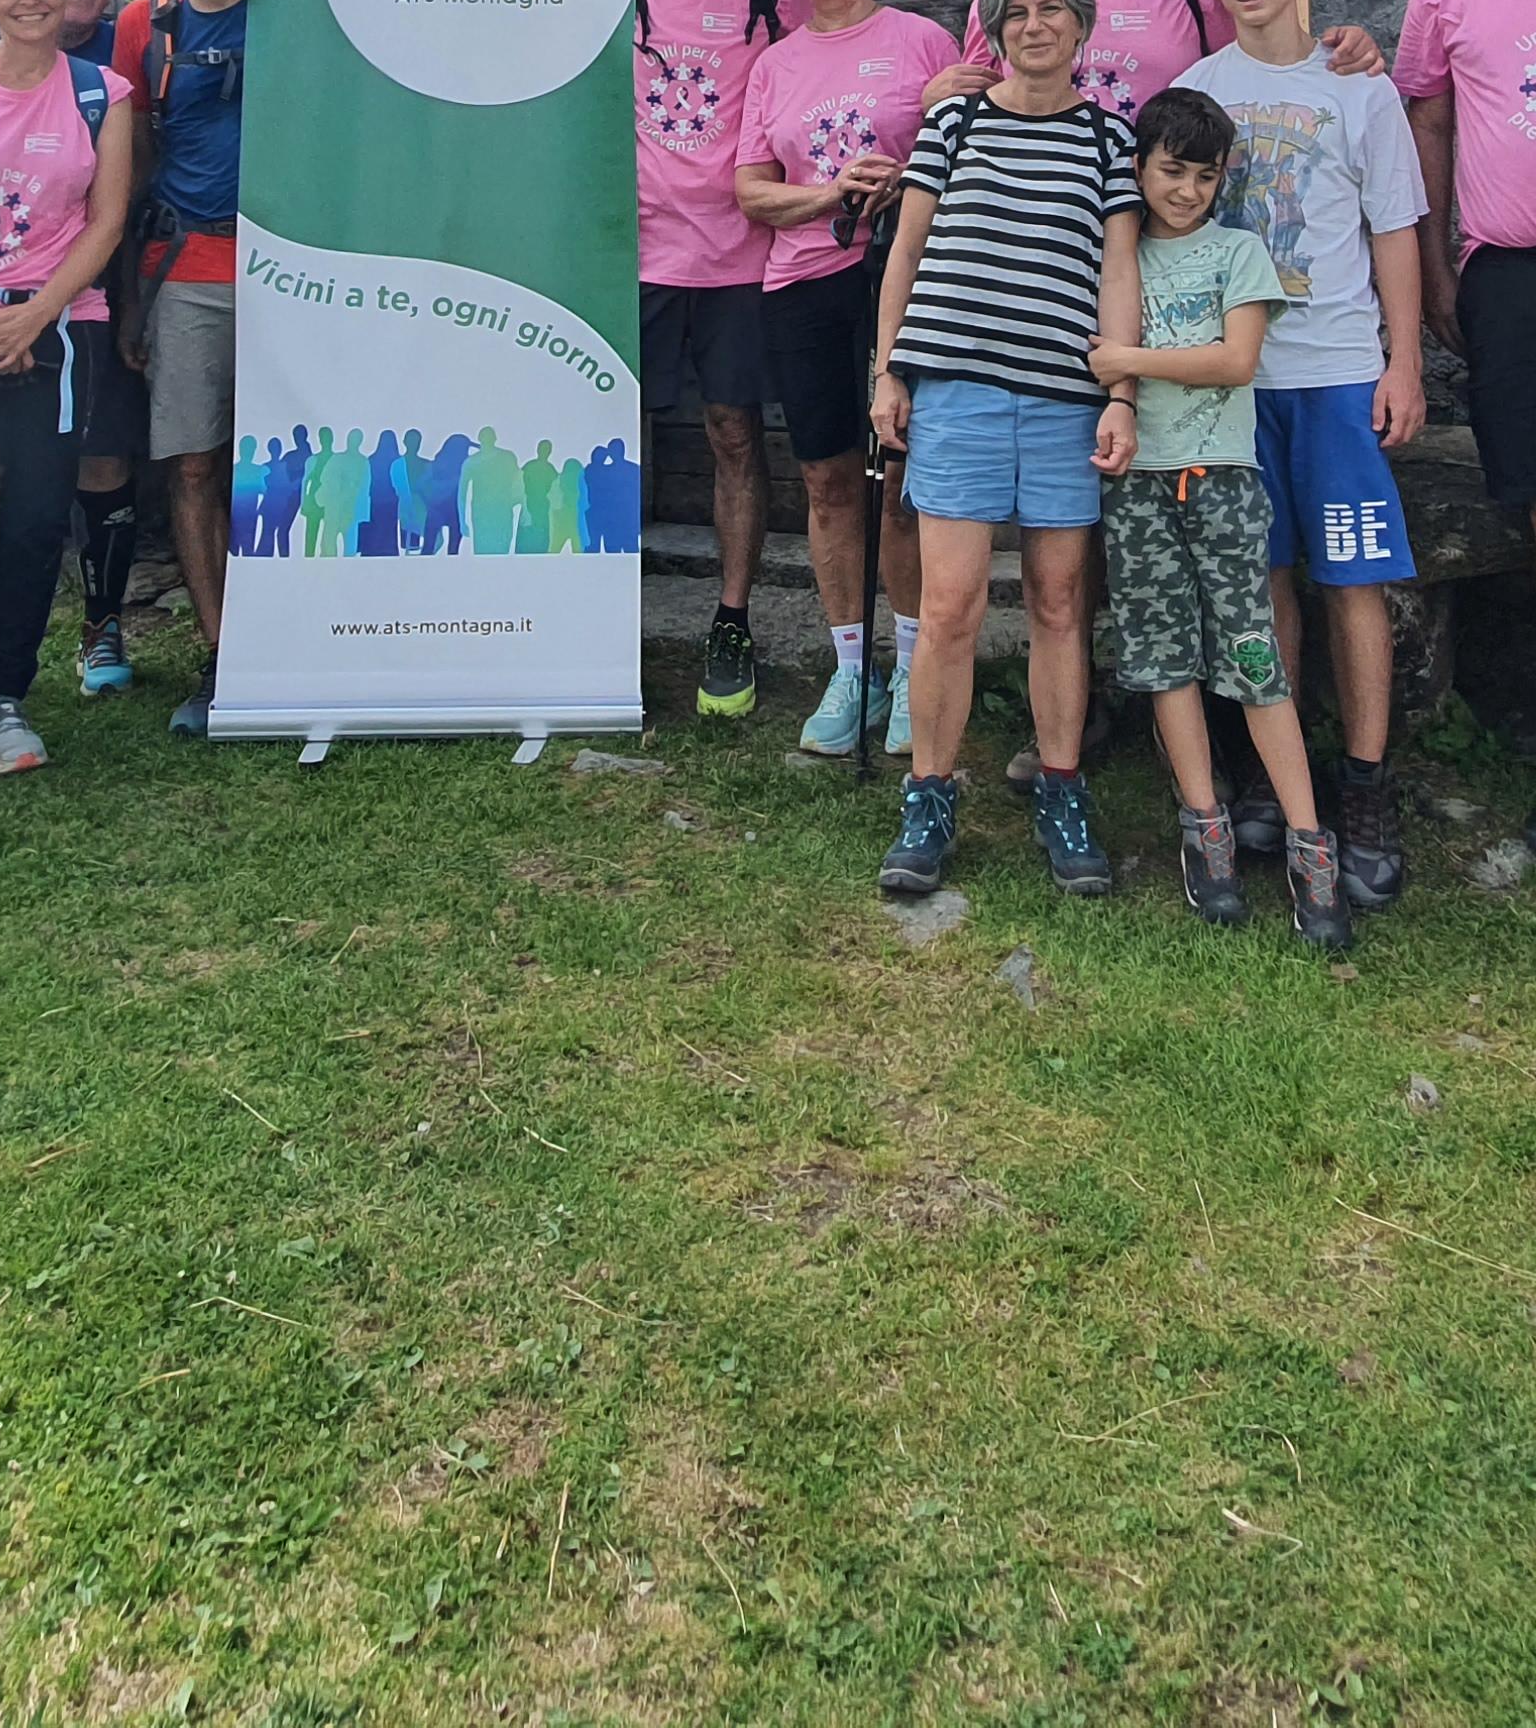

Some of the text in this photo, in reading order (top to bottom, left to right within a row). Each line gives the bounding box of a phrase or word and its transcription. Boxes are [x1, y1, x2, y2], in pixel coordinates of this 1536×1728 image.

[682, 44, 707, 59] per
[707, 50, 722, 68] la
[1090, 48, 1121, 64] per
[1122, 52, 1139, 72] la
[800, 92, 878, 123] Uniti per la
[638, 118, 726, 152] prevenzione
[2, 167, 28, 185] per
[26, 174, 42, 194] la
[245, 247, 616, 392] Vicini a te, ogni giorno
[330, 617, 533, 636] www.ats-montagna.it
